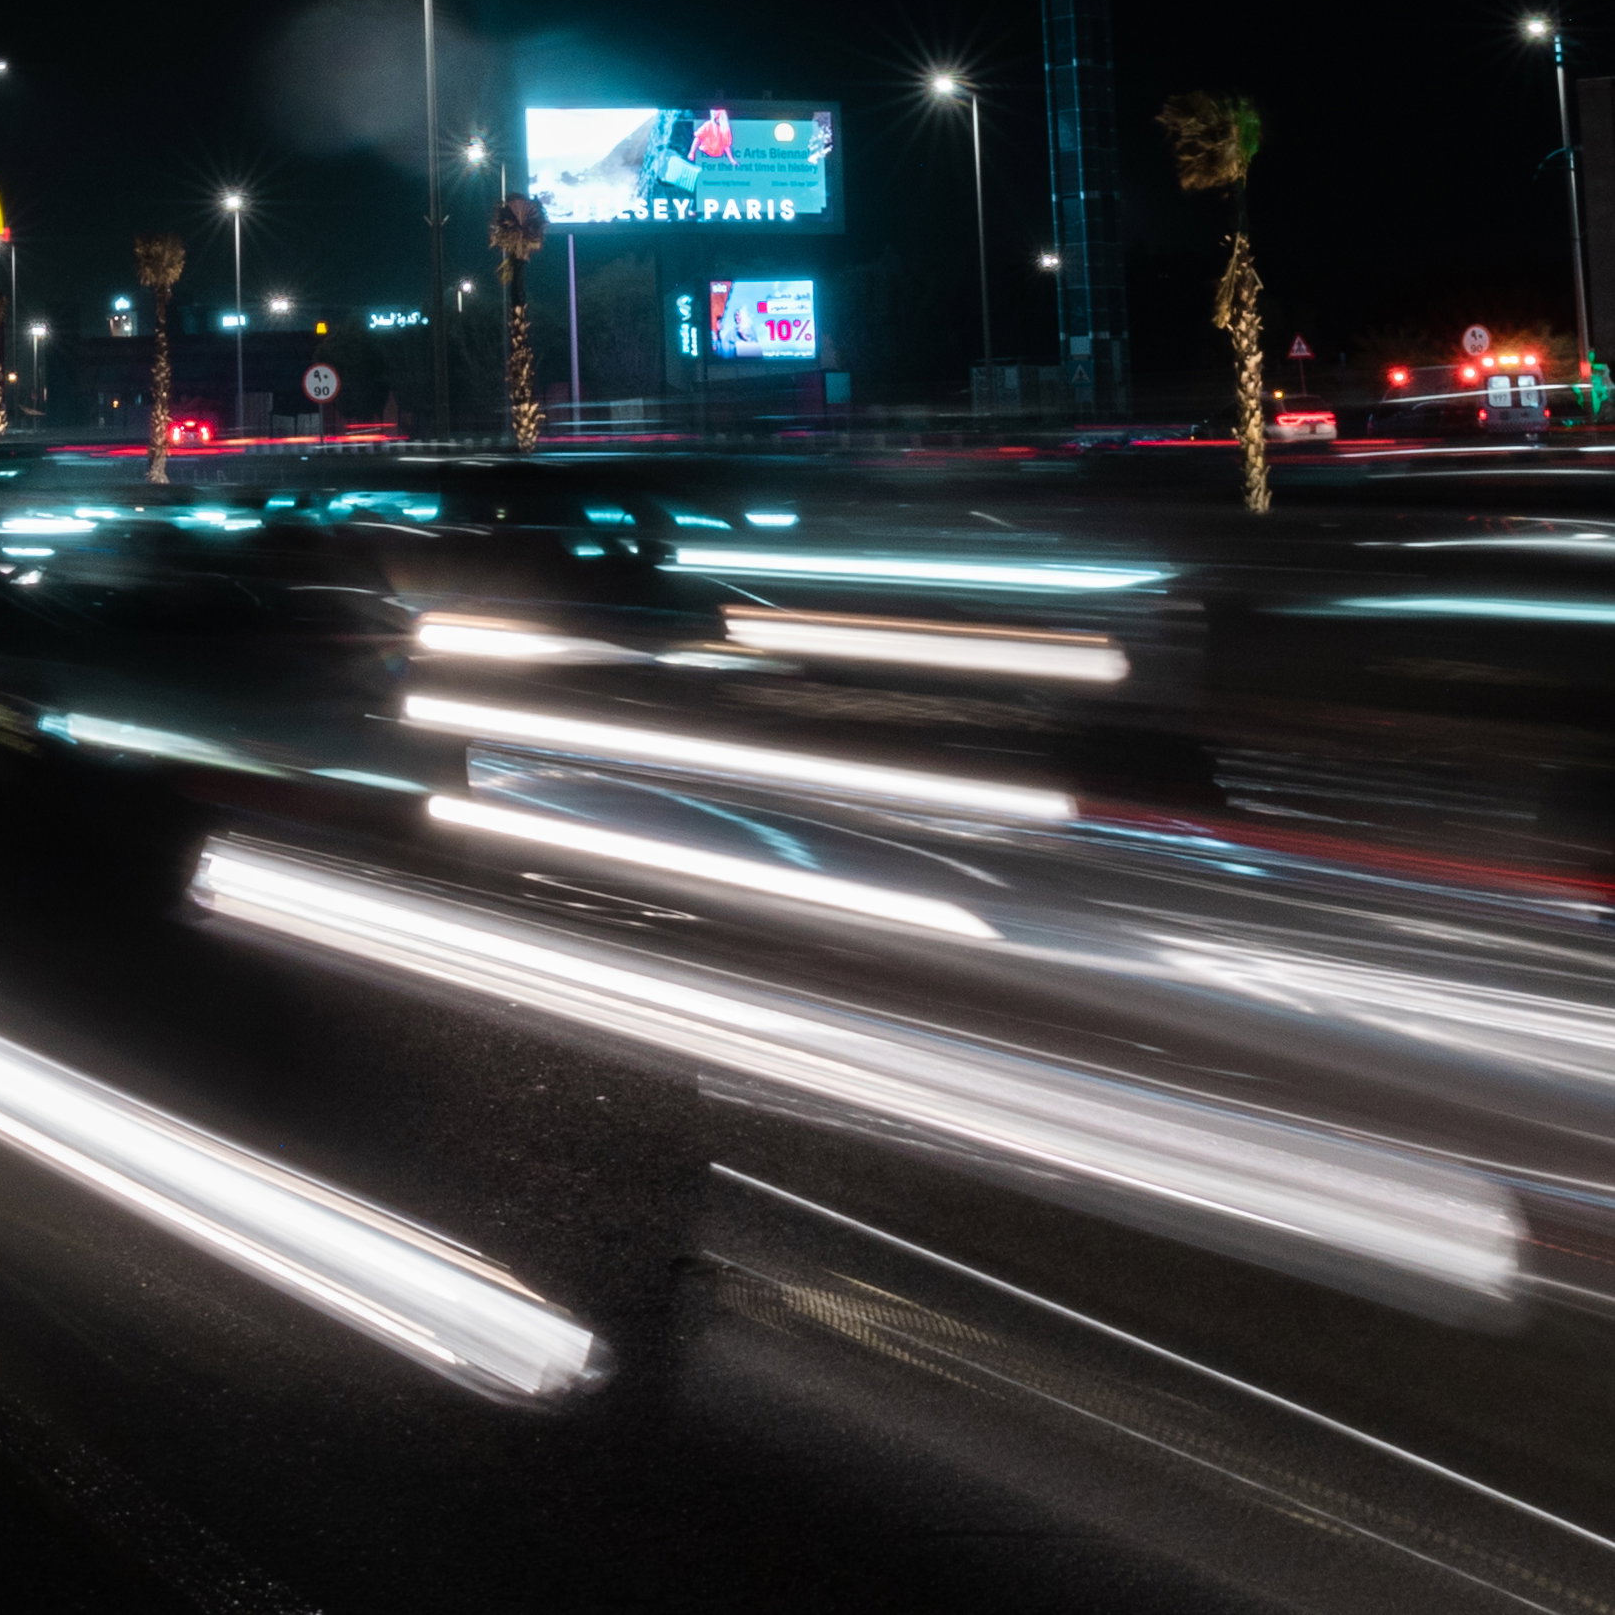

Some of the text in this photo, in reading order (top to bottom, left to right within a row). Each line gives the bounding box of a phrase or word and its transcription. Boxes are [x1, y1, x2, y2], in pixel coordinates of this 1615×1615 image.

[744, 148, 766, 159] Arts
[754, 163, 776, 172] time
[787, 163, 818, 174] history
[703, 198, 796, 221] PARIS
[764, 319, 812, 341] 10%
[313, 386, 330, 397] 90
